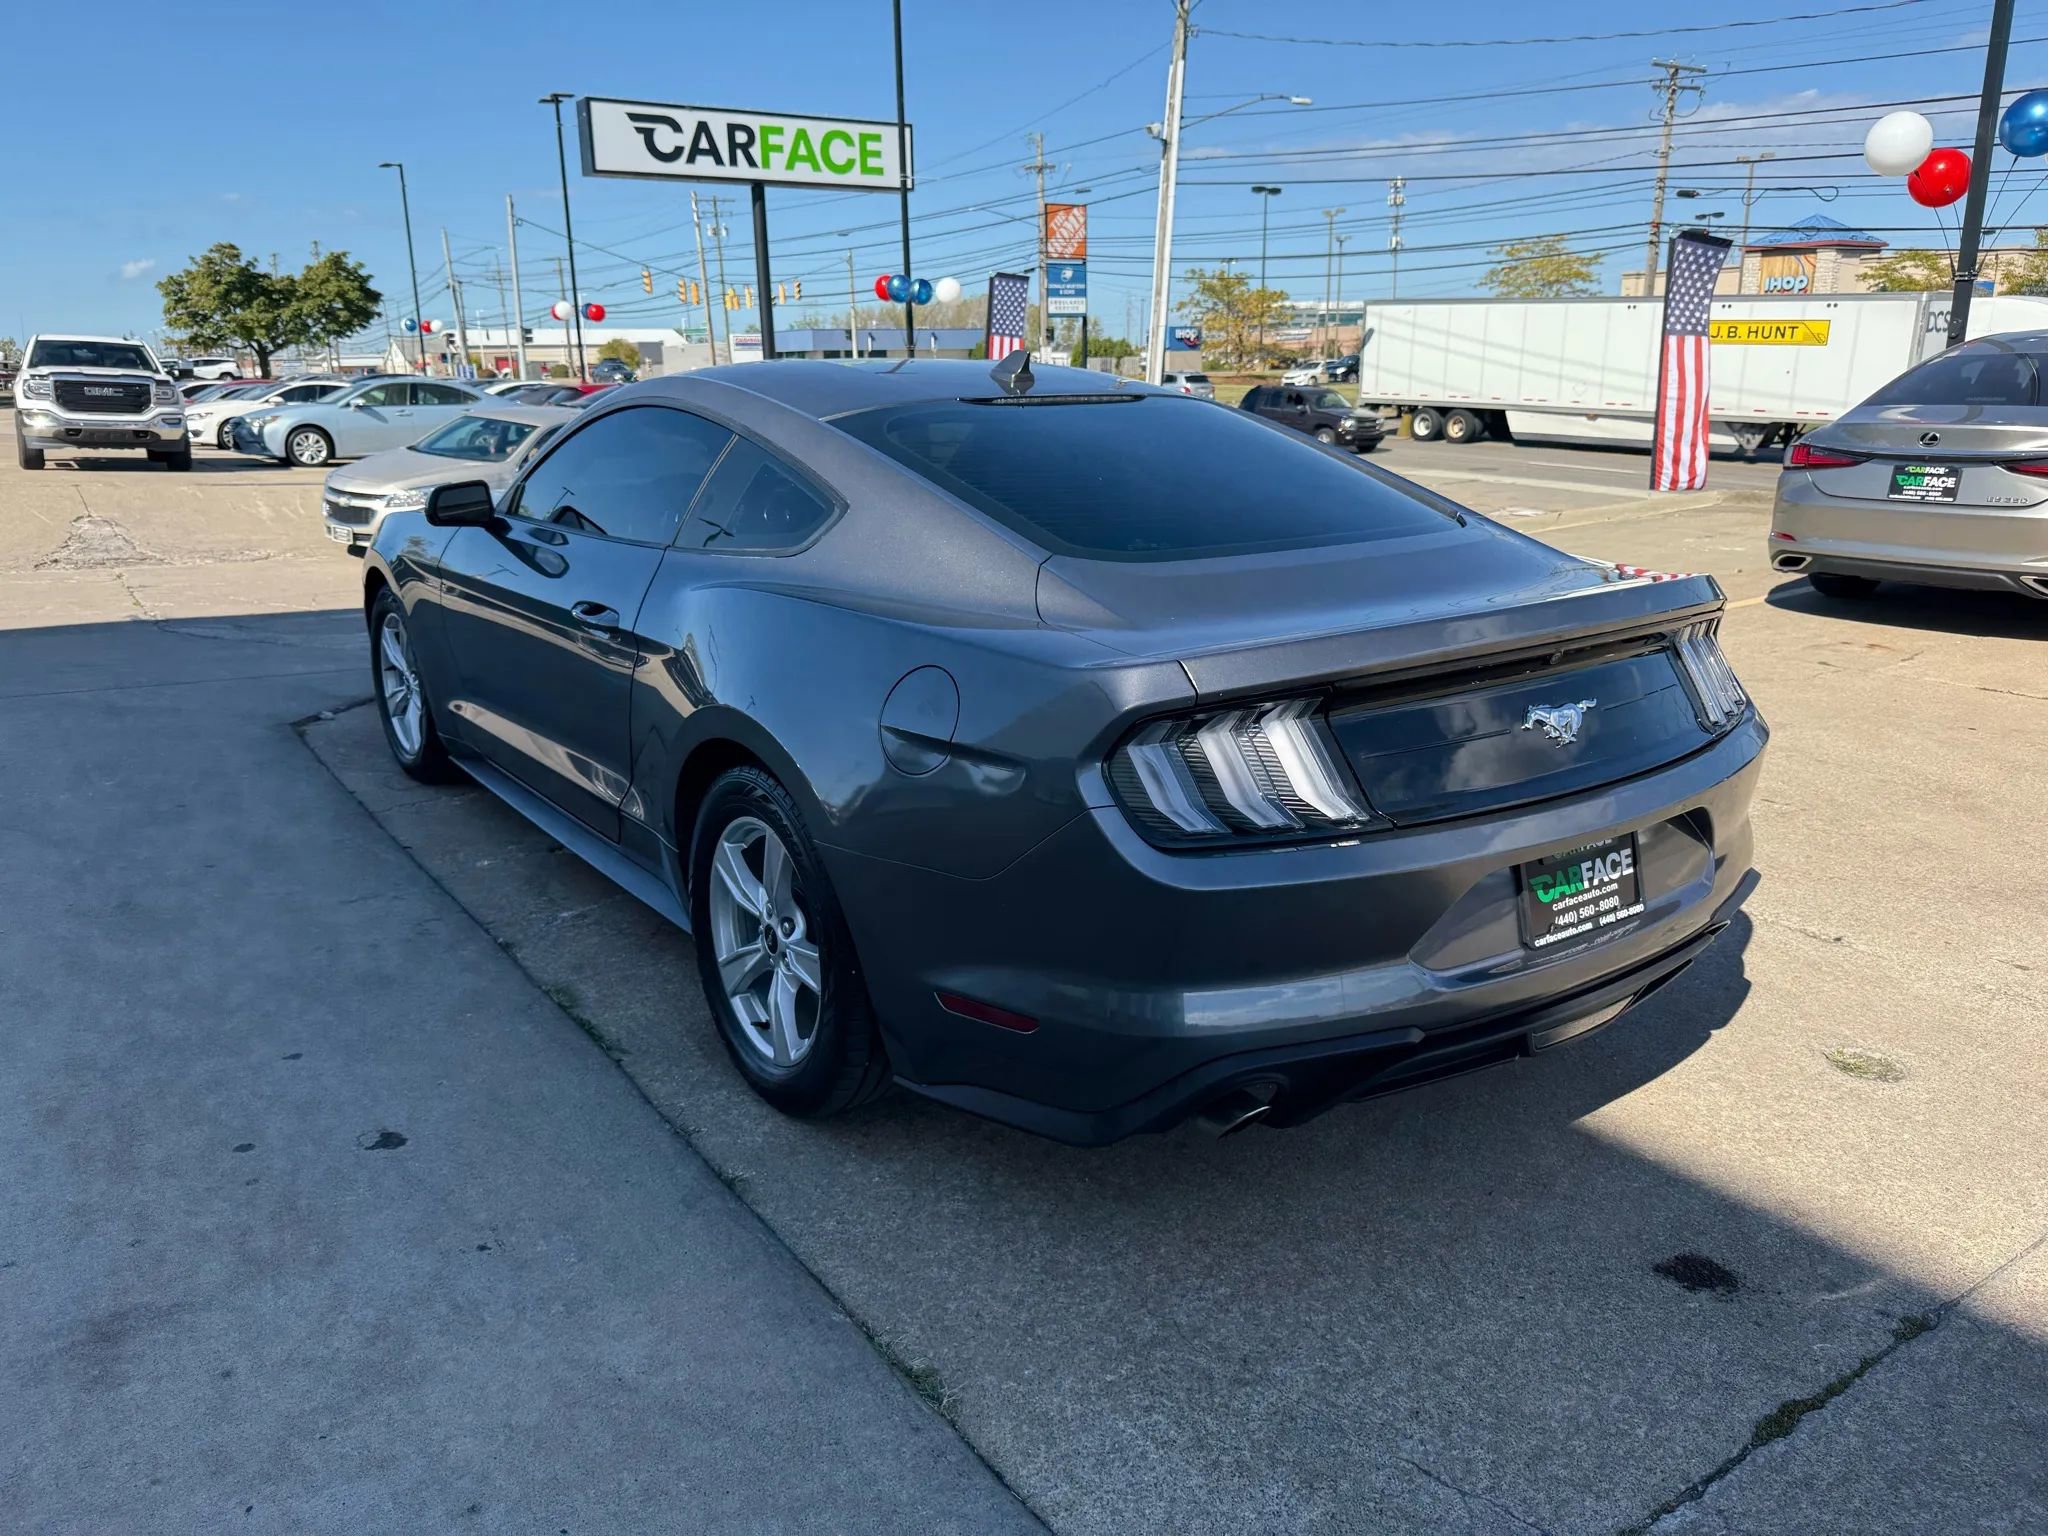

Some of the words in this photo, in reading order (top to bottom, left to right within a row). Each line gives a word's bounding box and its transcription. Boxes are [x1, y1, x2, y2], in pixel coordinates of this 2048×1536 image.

[625, 112, 884, 175] CARFACE
[1747, 325, 1799, 340] HUNT
[84, 386, 125, 397] GMC
[1896, 474, 1957, 488] CARFACE
[1528, 848, 1634, 903] CARFACE
[1552, 883, 1618, 911] carfaceauto.com
